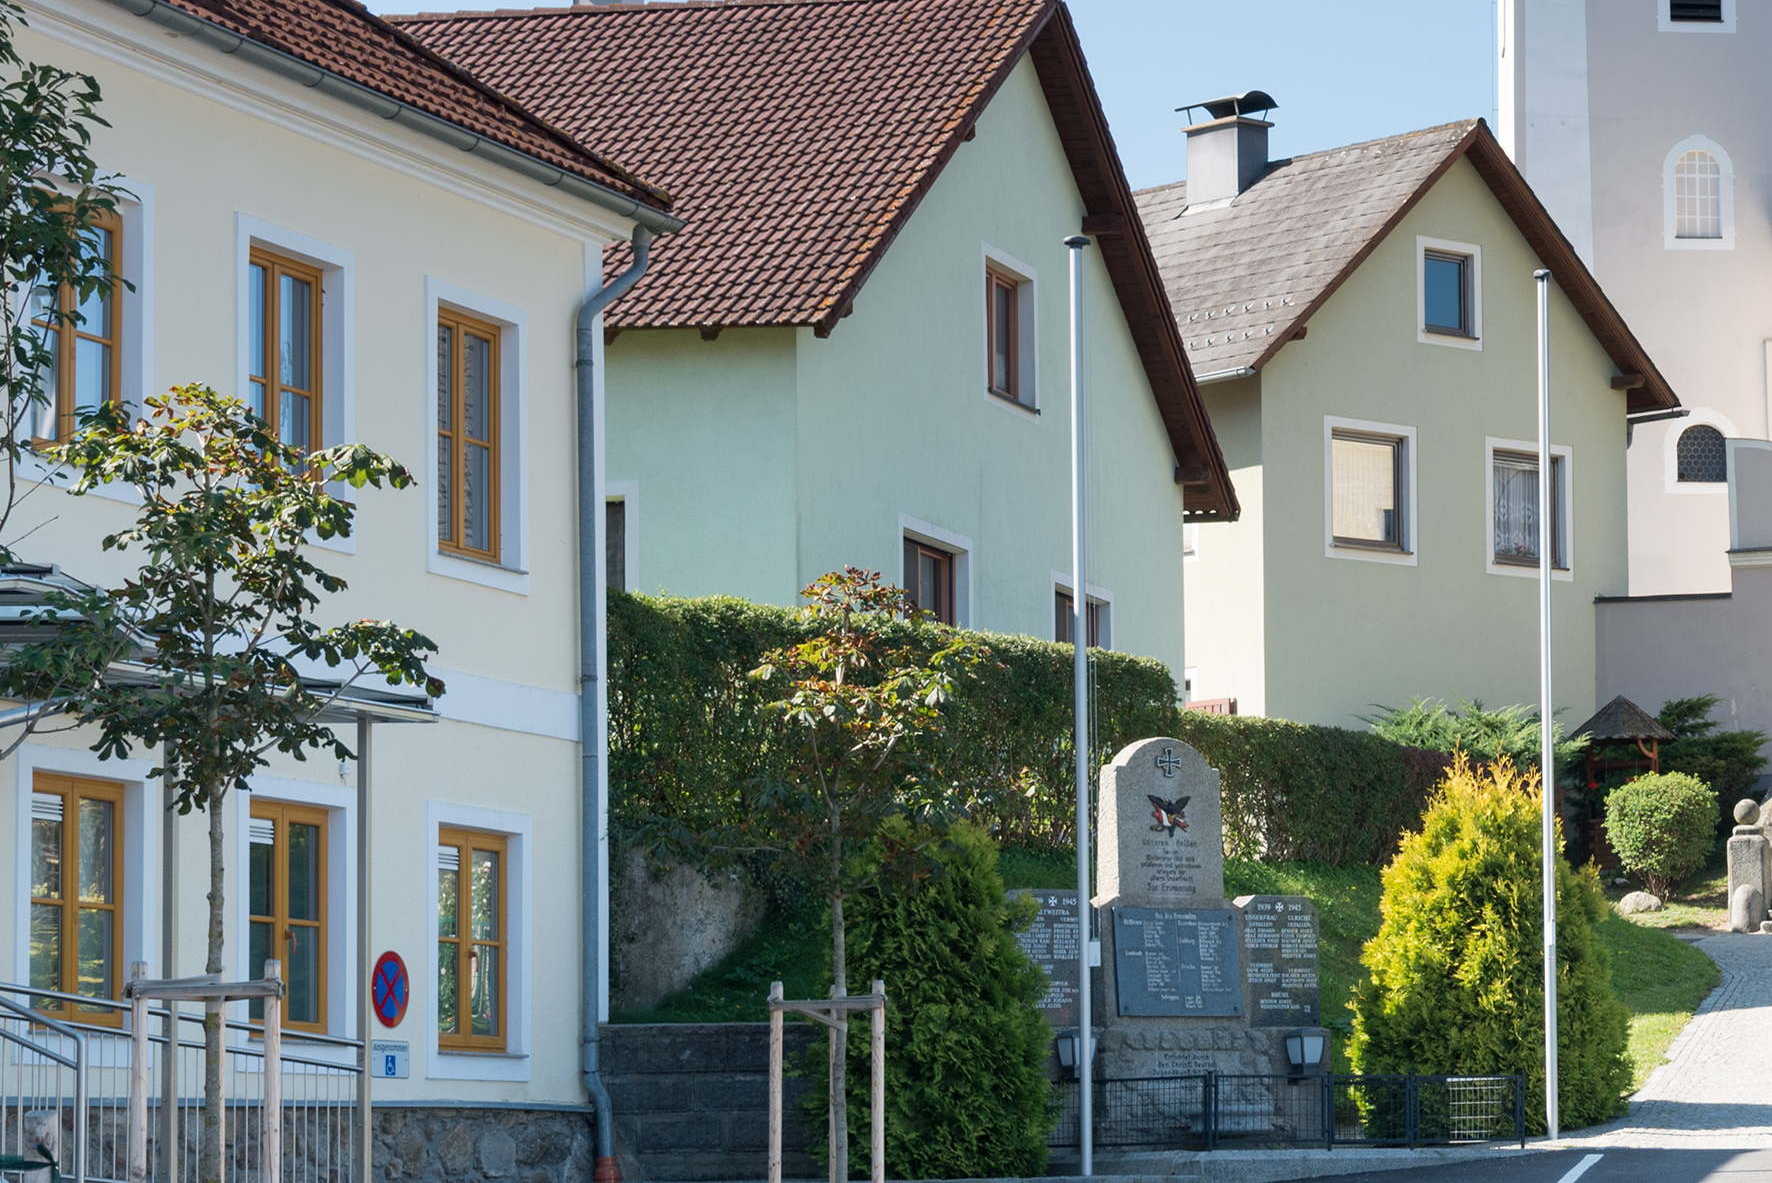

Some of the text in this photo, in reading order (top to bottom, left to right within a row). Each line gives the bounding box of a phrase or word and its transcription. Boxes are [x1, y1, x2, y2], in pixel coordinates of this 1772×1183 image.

[1062, 897, 1077, 905] 1945
[1257, 903, 1302, 911] 1939 1945
[373, 1043, 408, 1053] ausgenommen
